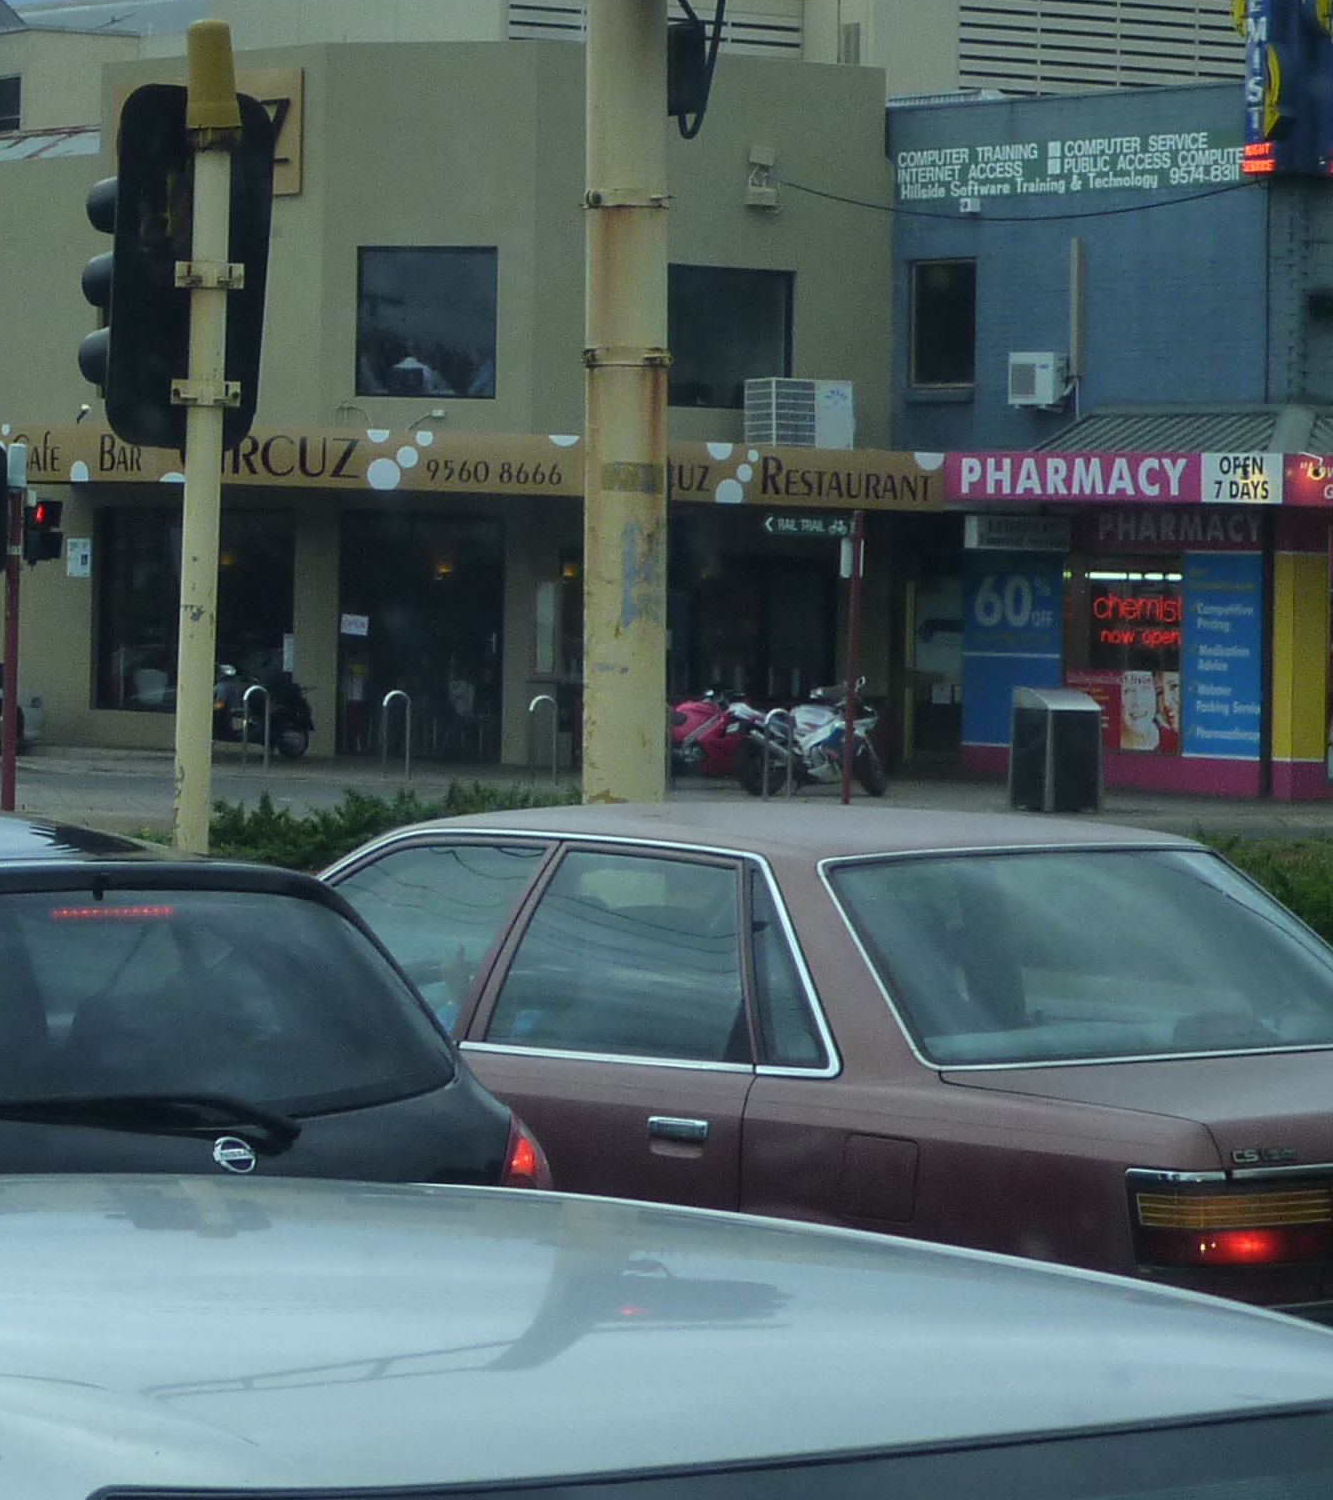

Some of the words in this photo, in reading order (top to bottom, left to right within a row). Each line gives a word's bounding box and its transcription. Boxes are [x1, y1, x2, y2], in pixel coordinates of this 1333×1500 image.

[897, 148, 969, 168] COMPUTER
[976, 143, 1038, 162] TRAINING
[1064, 137, 1140, 157] COMPUTER
[1148, 132, 1208, 152] SERVICE
[897, 165, 961, 184] INTERNET
[968, 161, 1023, 180] ACCESS
[1064, 155, 1110, 174] PUBLIC
[1117, 152, 1171, 171] ACCESS
[1169, 165, 1239, 184] 9574-8311
[901, 184, 945, 200] Hillside
[950, 181, 1010, 197] Software
[1016, 177, 1065, 193] Training
[1070, 174, 1082, 190] &
[1088, 172, 1158, 189] Technology
[426, 458, 490, 483] 9560
[499, 461, 563, 486] 8666
[961, 457, 1186, 496] PHARMACY
[1219, 456, 1264, 475] OPEN
[761, 456, 933, 501] RESTAURANT
[1214, 481, 1222, 499] 7
[1229, 481, 1269, 499] DAYS
[778, 518, 797, 530] RAIL
[801, 519, 825, 532] TRAIL
[1099, 511, 1260, 542] PHARMACY
[975, 575, 1032, 627] 60
[1100, 629, 1134, 643] now
